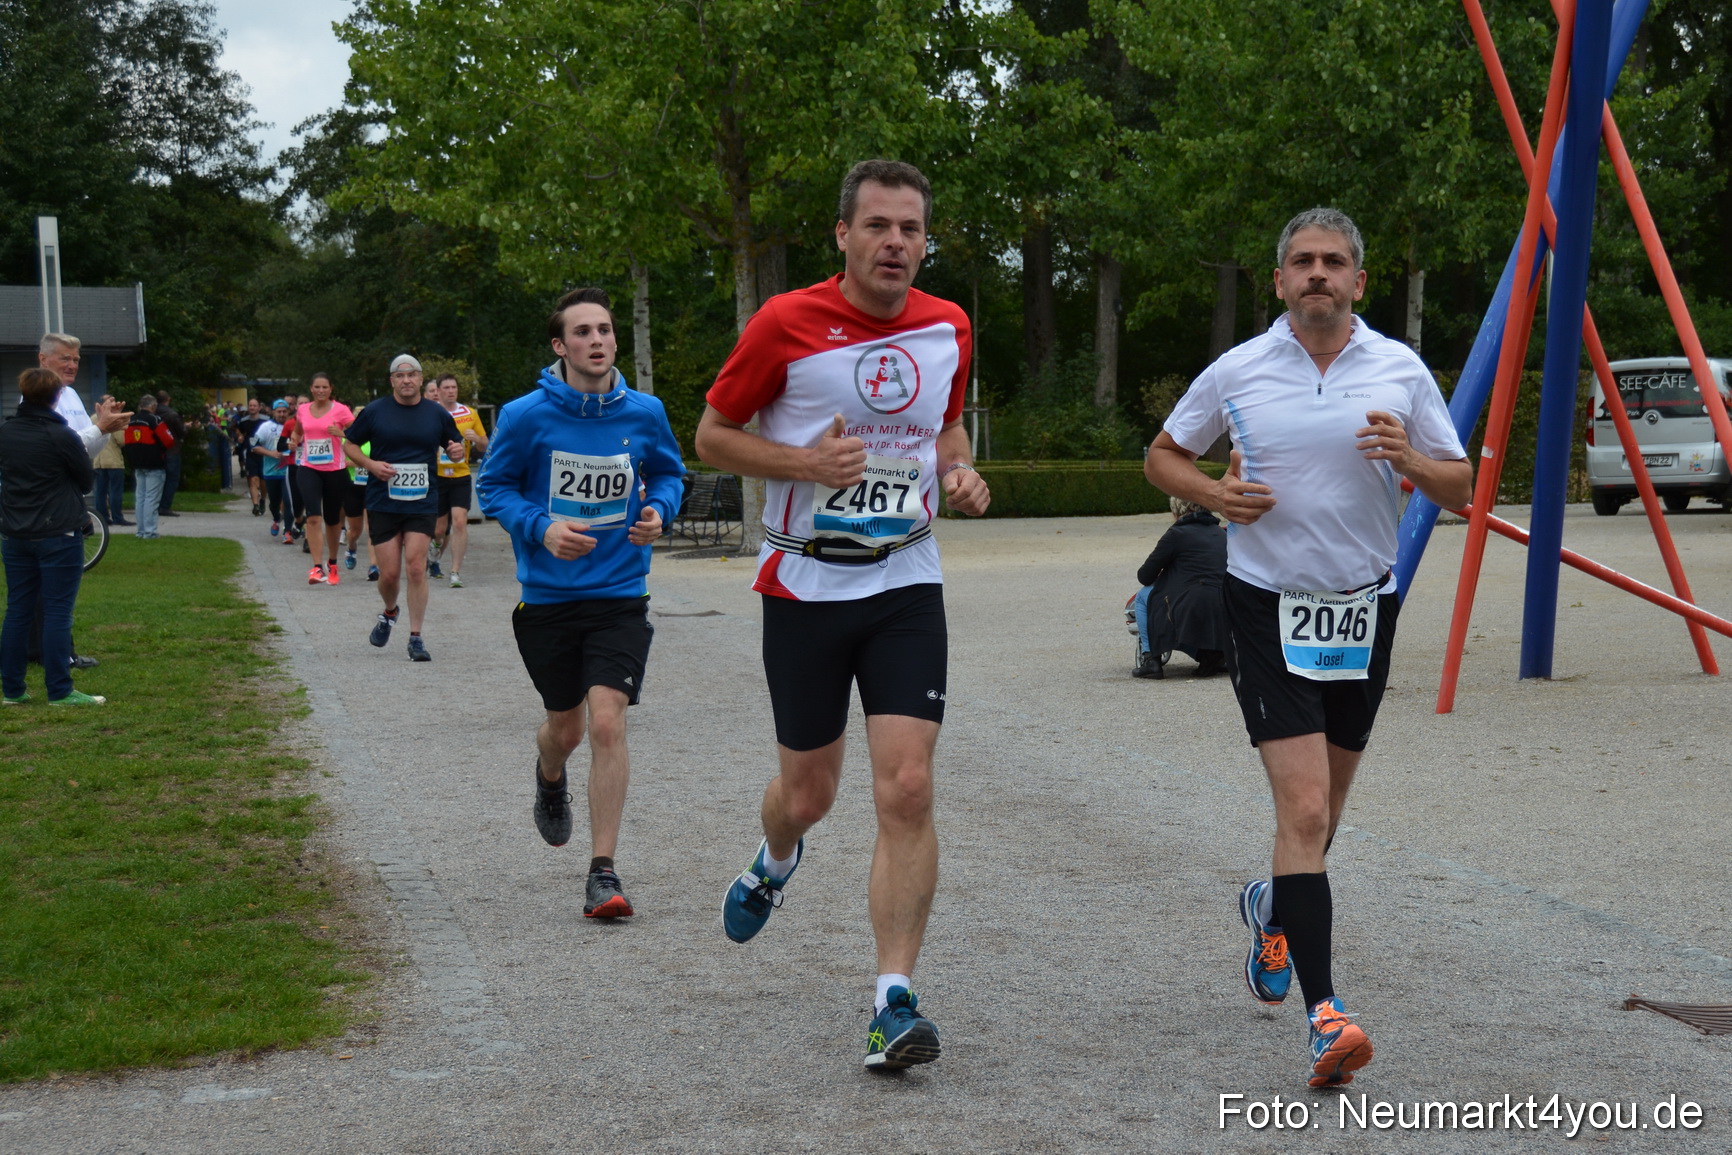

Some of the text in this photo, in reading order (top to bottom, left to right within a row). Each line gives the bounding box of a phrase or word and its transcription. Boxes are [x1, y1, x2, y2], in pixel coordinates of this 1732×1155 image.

[841, 424, 875, 437] AUFEN
[879, 424, 902, 435] MIT
[309, 443, 330, 455] 2784
[880, 441, 893, 449] Dr.
[553, 458, 582, 468] PARTL
[392, 473, 426, 487] 2228
[559, 470, 627, 499] 2409
[825, 479, 910, 514] 2467
[580, 505, 602, 516] Max
[851, 520, 880, 535] Willi
[1283, 590, 1317, 604] PARTL
[1291, 606, 1369, 642] 2046
[1315, 652, 1345, 667] Josef
